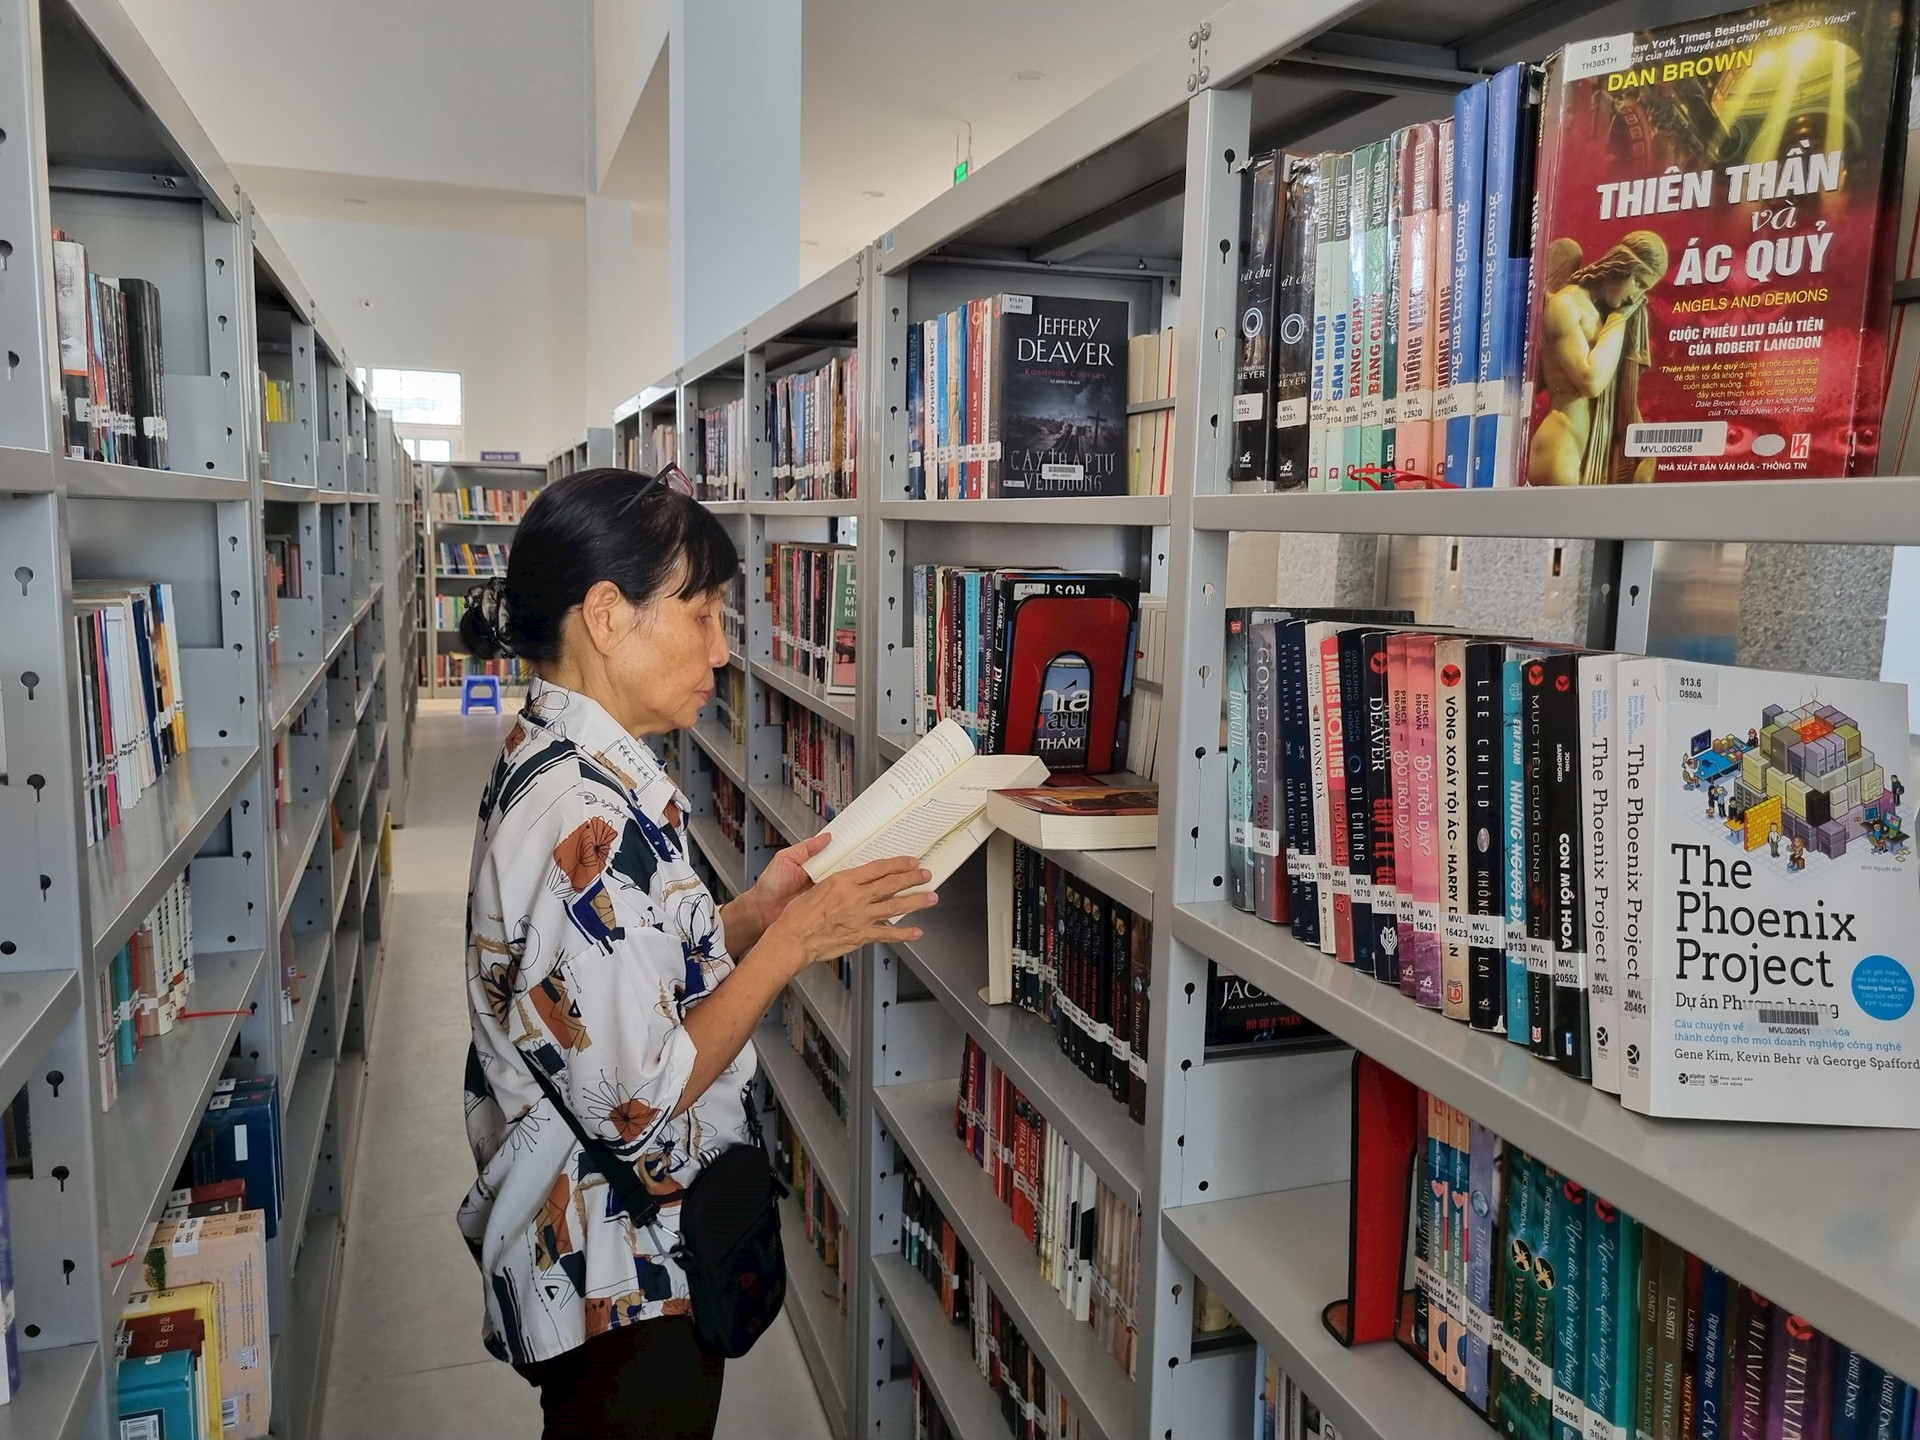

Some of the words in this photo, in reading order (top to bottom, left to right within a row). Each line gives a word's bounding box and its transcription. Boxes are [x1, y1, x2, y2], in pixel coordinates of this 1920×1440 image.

[1652, 36, 1677, 50] York
[1678, 29, 1711, 45] Times
[1714, 17, 1771, 36] Bestseller
[1591, 42, 1610, 55] 813
[1607, 69, 1655, 92] DAN
[1661, 49, 1754, 84] BROWN
[1597, 165, 1713, 221] THIÊN
[1725, 139, 1842, 204] THẦN
[1751, 201, 1798, 234] và
[1673, 237, 1732, 287] ÁC
[1745, 221, 1834, 283] QUỶ
[1452, 267, 1467, 322] trong
[1482, 262, 1497, 319] trong
[1672, 293, 1728, 314] ANGELS
[1730, 290, 1762, 309] AND
[1764, 288, 1828, 307] DEMONS
[1038, 314, 1101, 340] JEFFERY
[1018, 338, 1114, 366] DEAVER
[1714, 340, 1762, 356] ROBERT
[1763, 334, 1822, 352] LANGDON
[1024, 367, 1066, 378] Roadside
[1755, 407, 1773, 415] New
[1774, 406, 1791, 414] York
[1640, 445, 1693, 454] MVL.006268
[1794, 462, 1807, 470] TIN
[1323, 652, 1341, 704] JAMES
[1680, 677, 1702, 688] 813.6
[1477, 680, 1489, 717] LEE
[1679, 690, 1702, 700] D550A
[1229, 691, 1243, 748] DRACUL
[1445, 696, 1456, 740] VÒNG
[1531, 695, 1541, 735] MỤC
[1369, 697, 1384, 772] DEAVER
[1513, 718, 1522, 738] ETAF
[1038, 731, 1080, 750] THẢM
[1327, 705, 1345, 779] ROLLINS
[1313, 727, 1323, 778] HOANG
[1513, 740, 1521, 765] RUM
[1531, 741, 1542, 778] TIÊU
[1592, 737, 1608, 781] The
[1446, 745, 1457, 787] XOÁY
[1477, 739, 1489, 808] CHILD
[1628, 745, 1644, 790] The
[1447, 790, 1459, 814] TỘI
[1447, 819, 1459, 841] ÁC
[1592, 788, 1610, 879] Phoenix
[1559, 833, 1570, 868] CON
[1627, 797, 1644, 892] Phoenix
[1671, 843, 1753, 889] The
[1356, 878, 1367, 886] MVL
[1447, 854, 1458, 902] HARRY
[1560, 873, 1575, 905] MỒI
[1354, 889, 1370, 897] 16710
[1376, 900, 1395, 908] 15641
[1379, 890, 1392, 898] MVL
[1401, 901, 1413, 909] MVL
[1418, 909, 1433, 918] MVL
[1676, 890, 1857, 942] Phoenix
[1416, 922, 1437, 931] 16431
[1448, 915, 1464, 924] MVL
[1472, 923, 1490, 932] MVL
[1560, 909, 1572, 950] HOA
[1592, 886, 1609, 964] Project
[1445, 927, 1468, 938] 16423
[1469, 935, 1494, 945] 19242
[1507, 931, 1523, 940] MVL
[1624, 899, 1642, 980] Project
[1531, 944, 1544, 953] MVL
[1528, 957, 1548, 968] 17741
[1558, 959, 1574, 969] MVL
[1676, 938, 1834, 996] Project
[1555, 973, 1578, 984] 20552
[1595, 972, 1609, 983] MVL
[1592, 985, 1613, 996] 20452
[1628, 990, 1643, 1000] MVL
[1624, 1003, 1646, 1015] 20451
[1675, 992, 1698, 1015] Dự
[1700, 993, 1718, 1009] án
[1674, 1020, 1692, 1031] Câu
[1695, 1020, 1730, 1034] chuyện
[1768, 1026, 1810, 1035] MVL.020451
[1674, 1032, 1702, 1043] thành
[1704, 1033, 1729, 1046] công
[1731, 1035, 1750, 1045] cho
[1752, 1036, 1771, 1047] mọi
[1774, 1036, 1806, 1047] doanh
[1808, 1036, 1845, 1051] nghiệp
[1847, 1039, 1873, 1053] công
[1875, 1041, 1901, 1054] nghệ
[1674, 1049, 1703, 1061] Gene
[1706, 1050, 1733, 1064] Kim,
[1736, 1051, 1770, 1063] Kevin
[1773, 1053, 1801, 1065] Behr
[1806, 1054, 1820, 1066] và
[1822, 1056, 1867, 1070] George
[1869, 1057, 1920, 1071] Spafford
[1469, 1307, 1481, 1320] MVV
[1504, 1338, 1517, 1352] MVV
[1527, 1356, 1540, 1372] MVV
[1524, 1366, 1542, 1386] 27698
[1704, 1364, 1716, 1388] Pike
[1558, 1391, 1575, 1405] MVV
[1844, 1381, 1861, 1419] JONES
[1554, 1404, 1579, 1423] 29495
